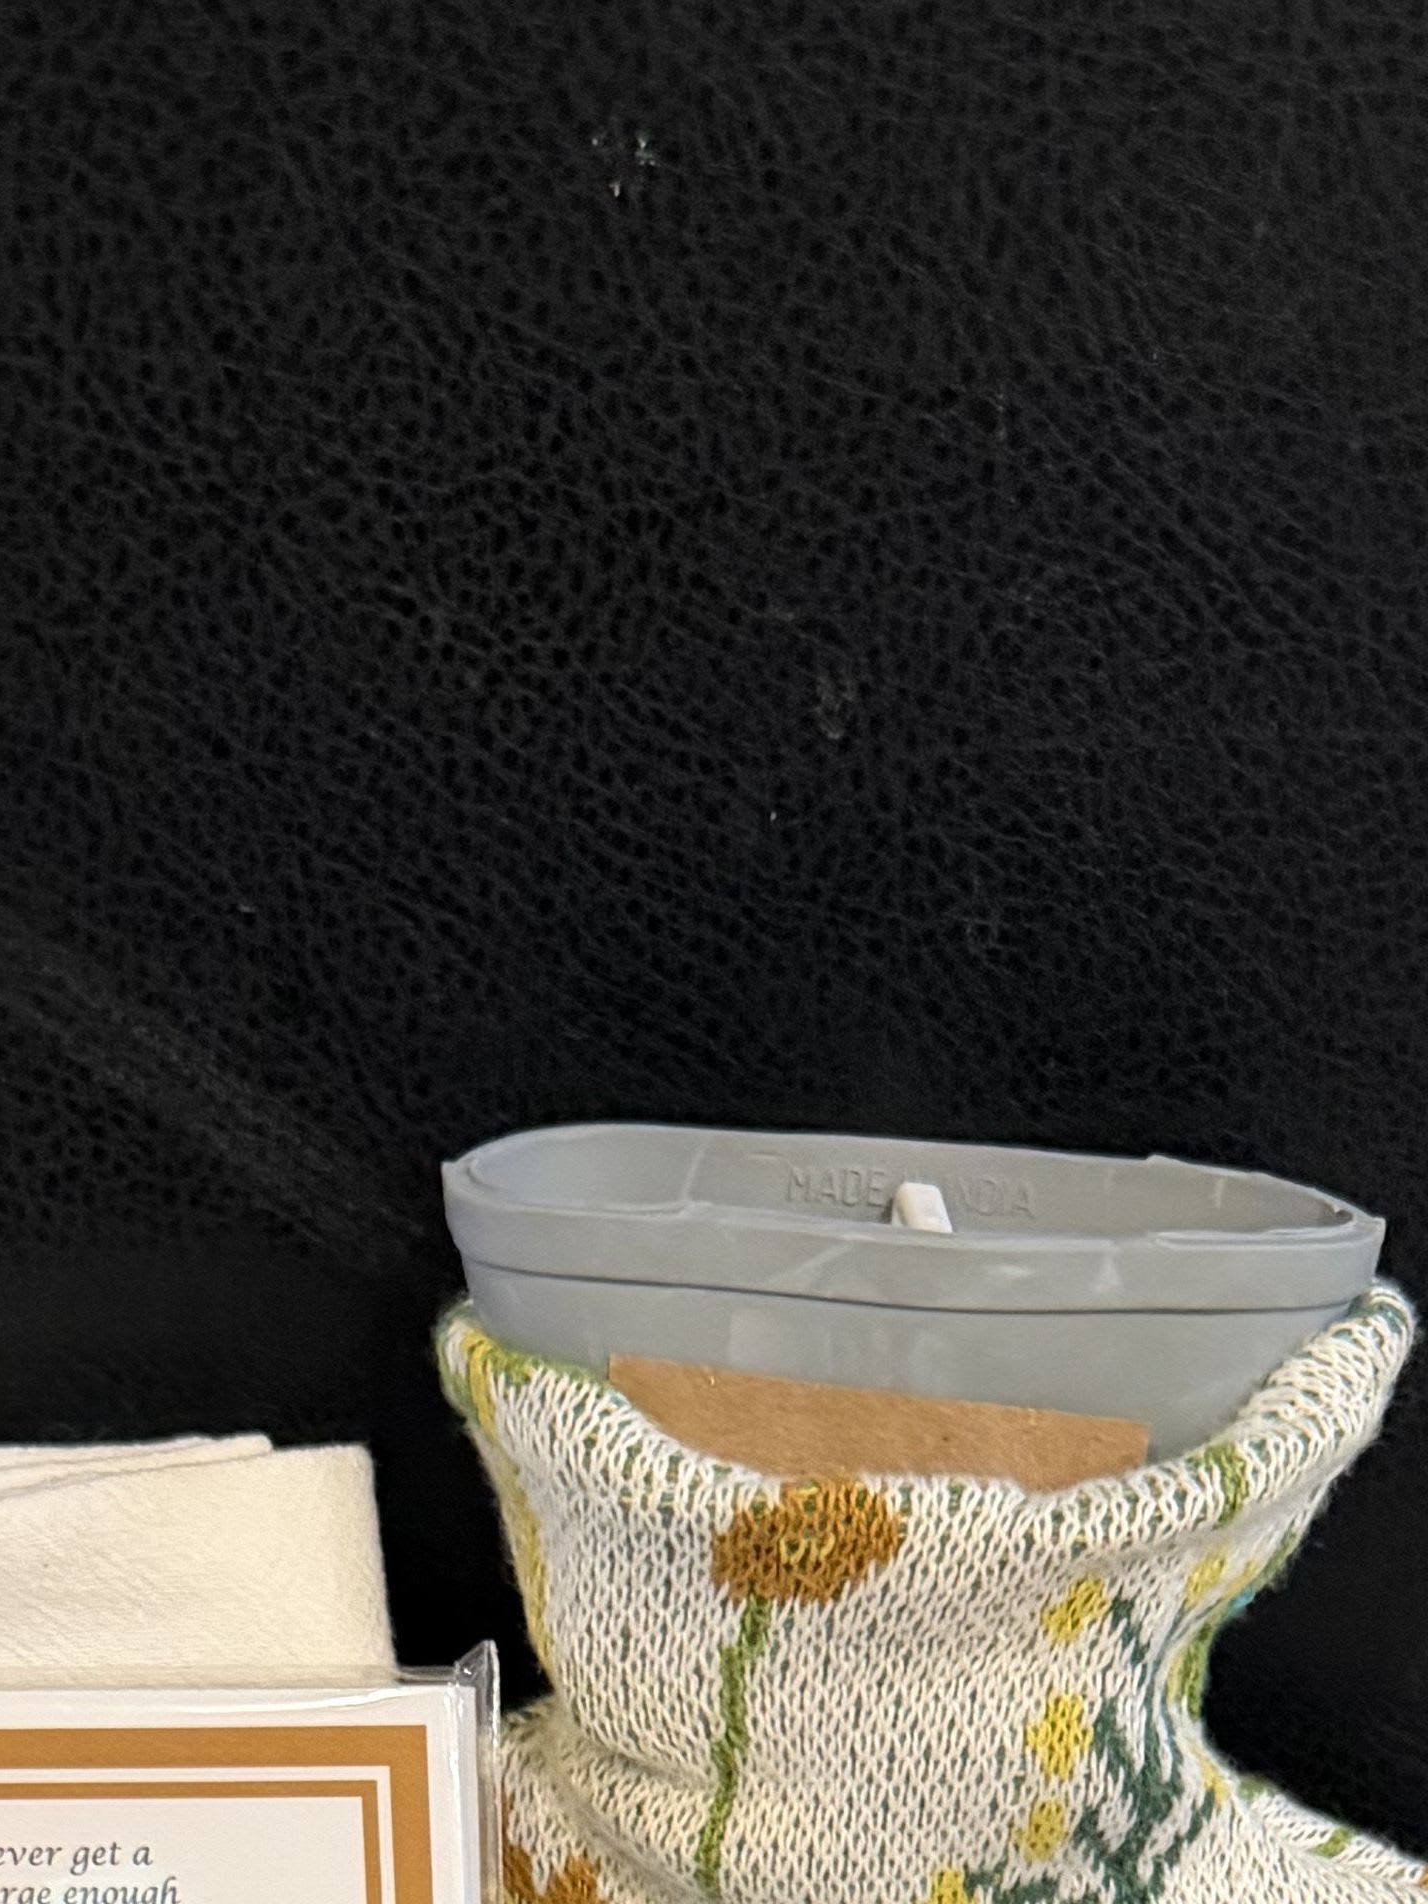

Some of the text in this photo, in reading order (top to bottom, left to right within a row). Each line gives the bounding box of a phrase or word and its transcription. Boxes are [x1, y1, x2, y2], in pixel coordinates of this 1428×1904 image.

[784, 1165, 886, 1209] MADE
[70, 1842, 122, 1875] get
[132, 1846, 153, 1867] a
